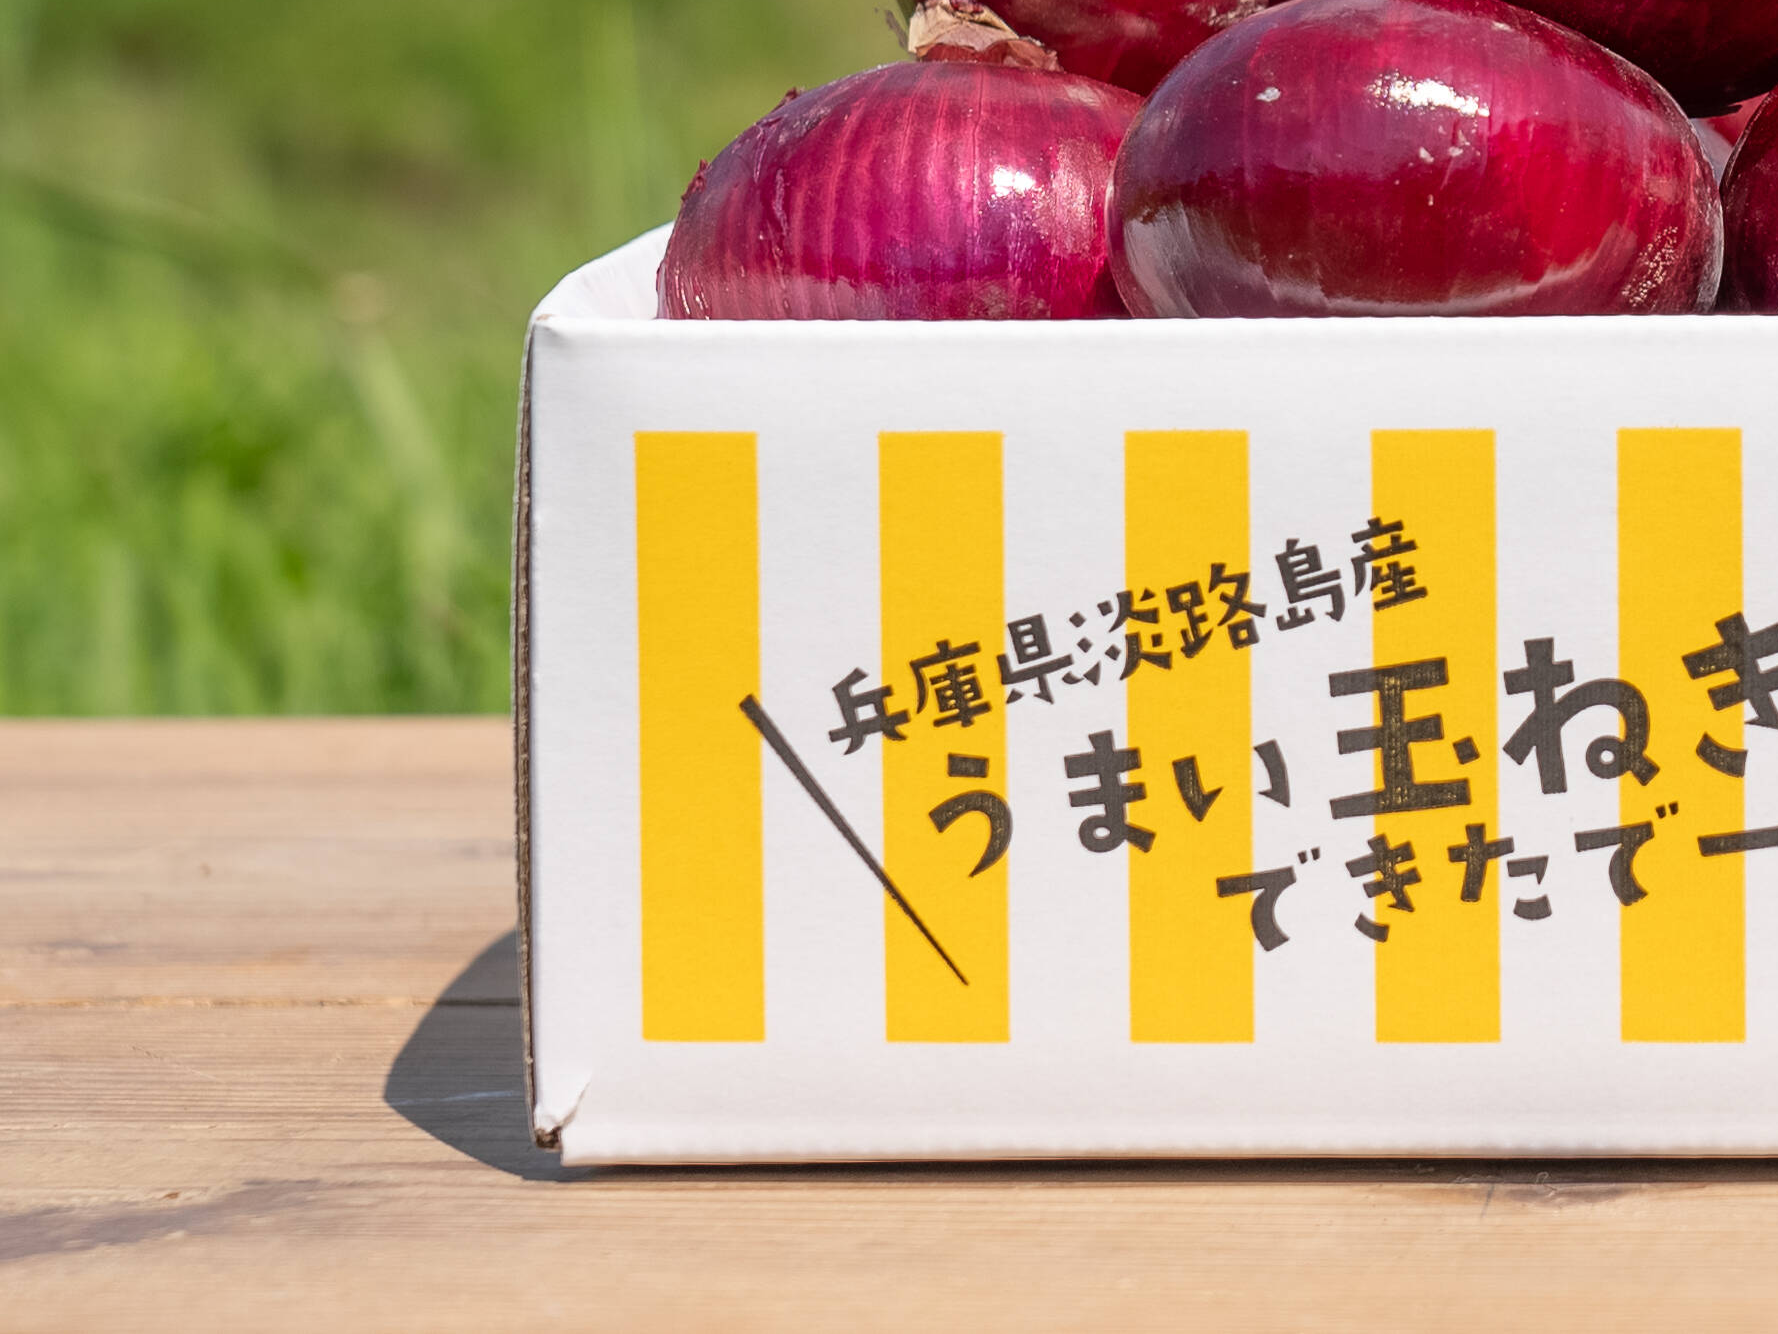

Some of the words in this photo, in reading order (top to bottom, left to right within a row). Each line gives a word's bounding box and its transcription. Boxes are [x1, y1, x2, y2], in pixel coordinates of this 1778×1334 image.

[827, 516, 1429, 757] 兵庫県淡路島産
